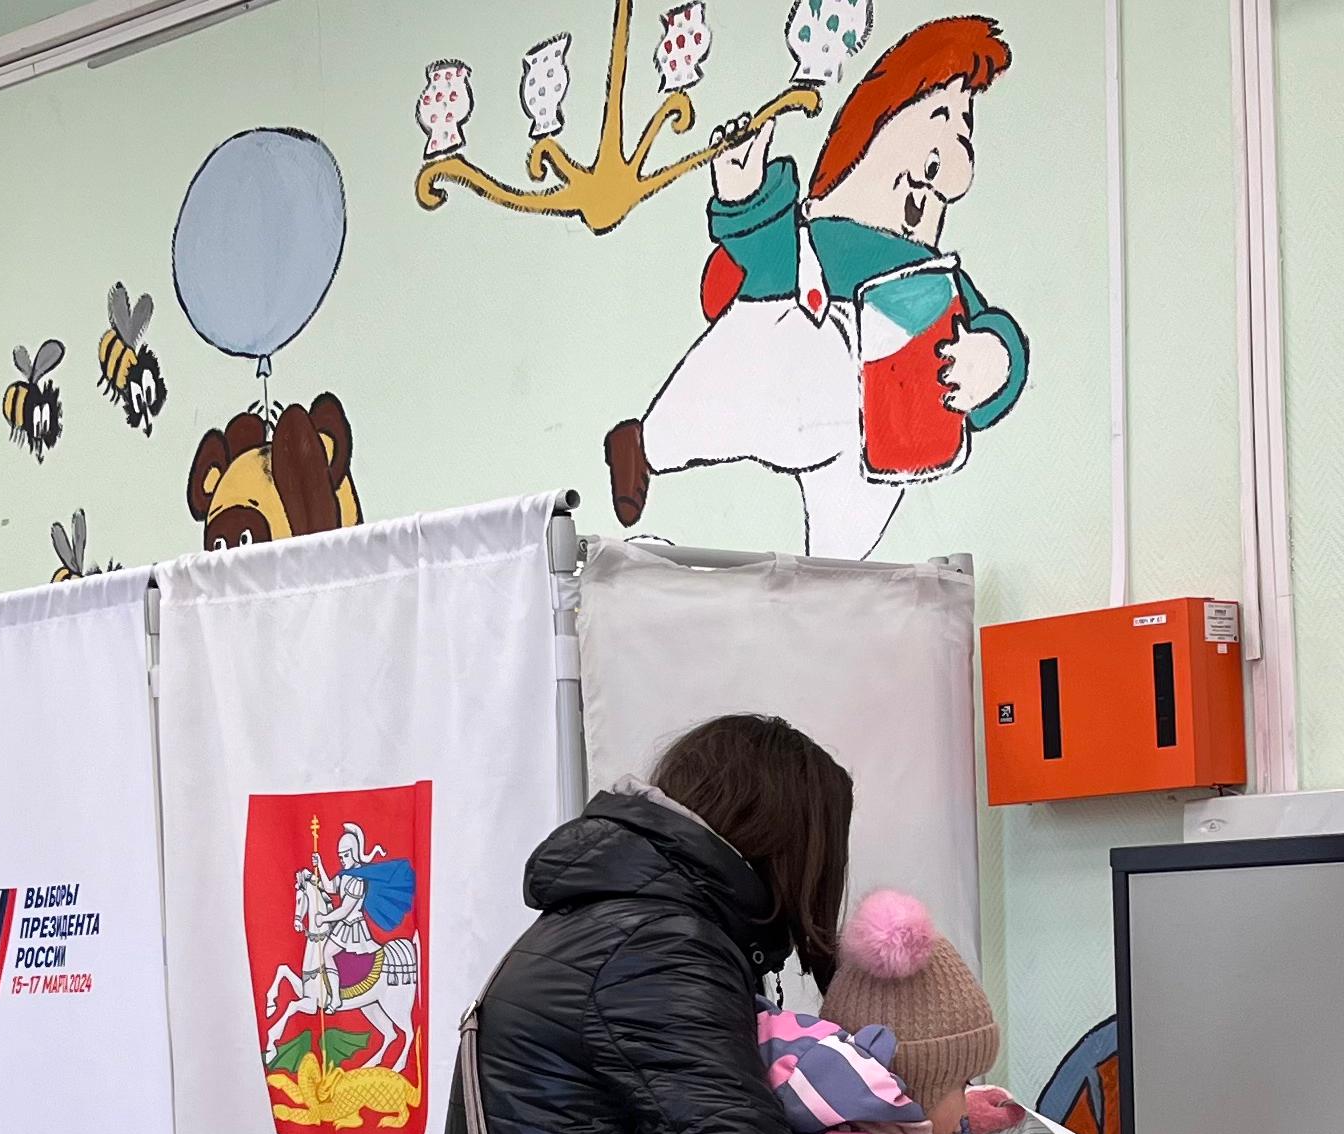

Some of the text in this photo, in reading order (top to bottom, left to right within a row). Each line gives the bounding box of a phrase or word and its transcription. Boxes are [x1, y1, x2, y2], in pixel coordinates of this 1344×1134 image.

[24, 883, 80, 909] ВЫБОРЫ
[19, 913, 100, 939] ПРЕЗИДЕНТА
[15, 945, 67, 969] РОССИИ
